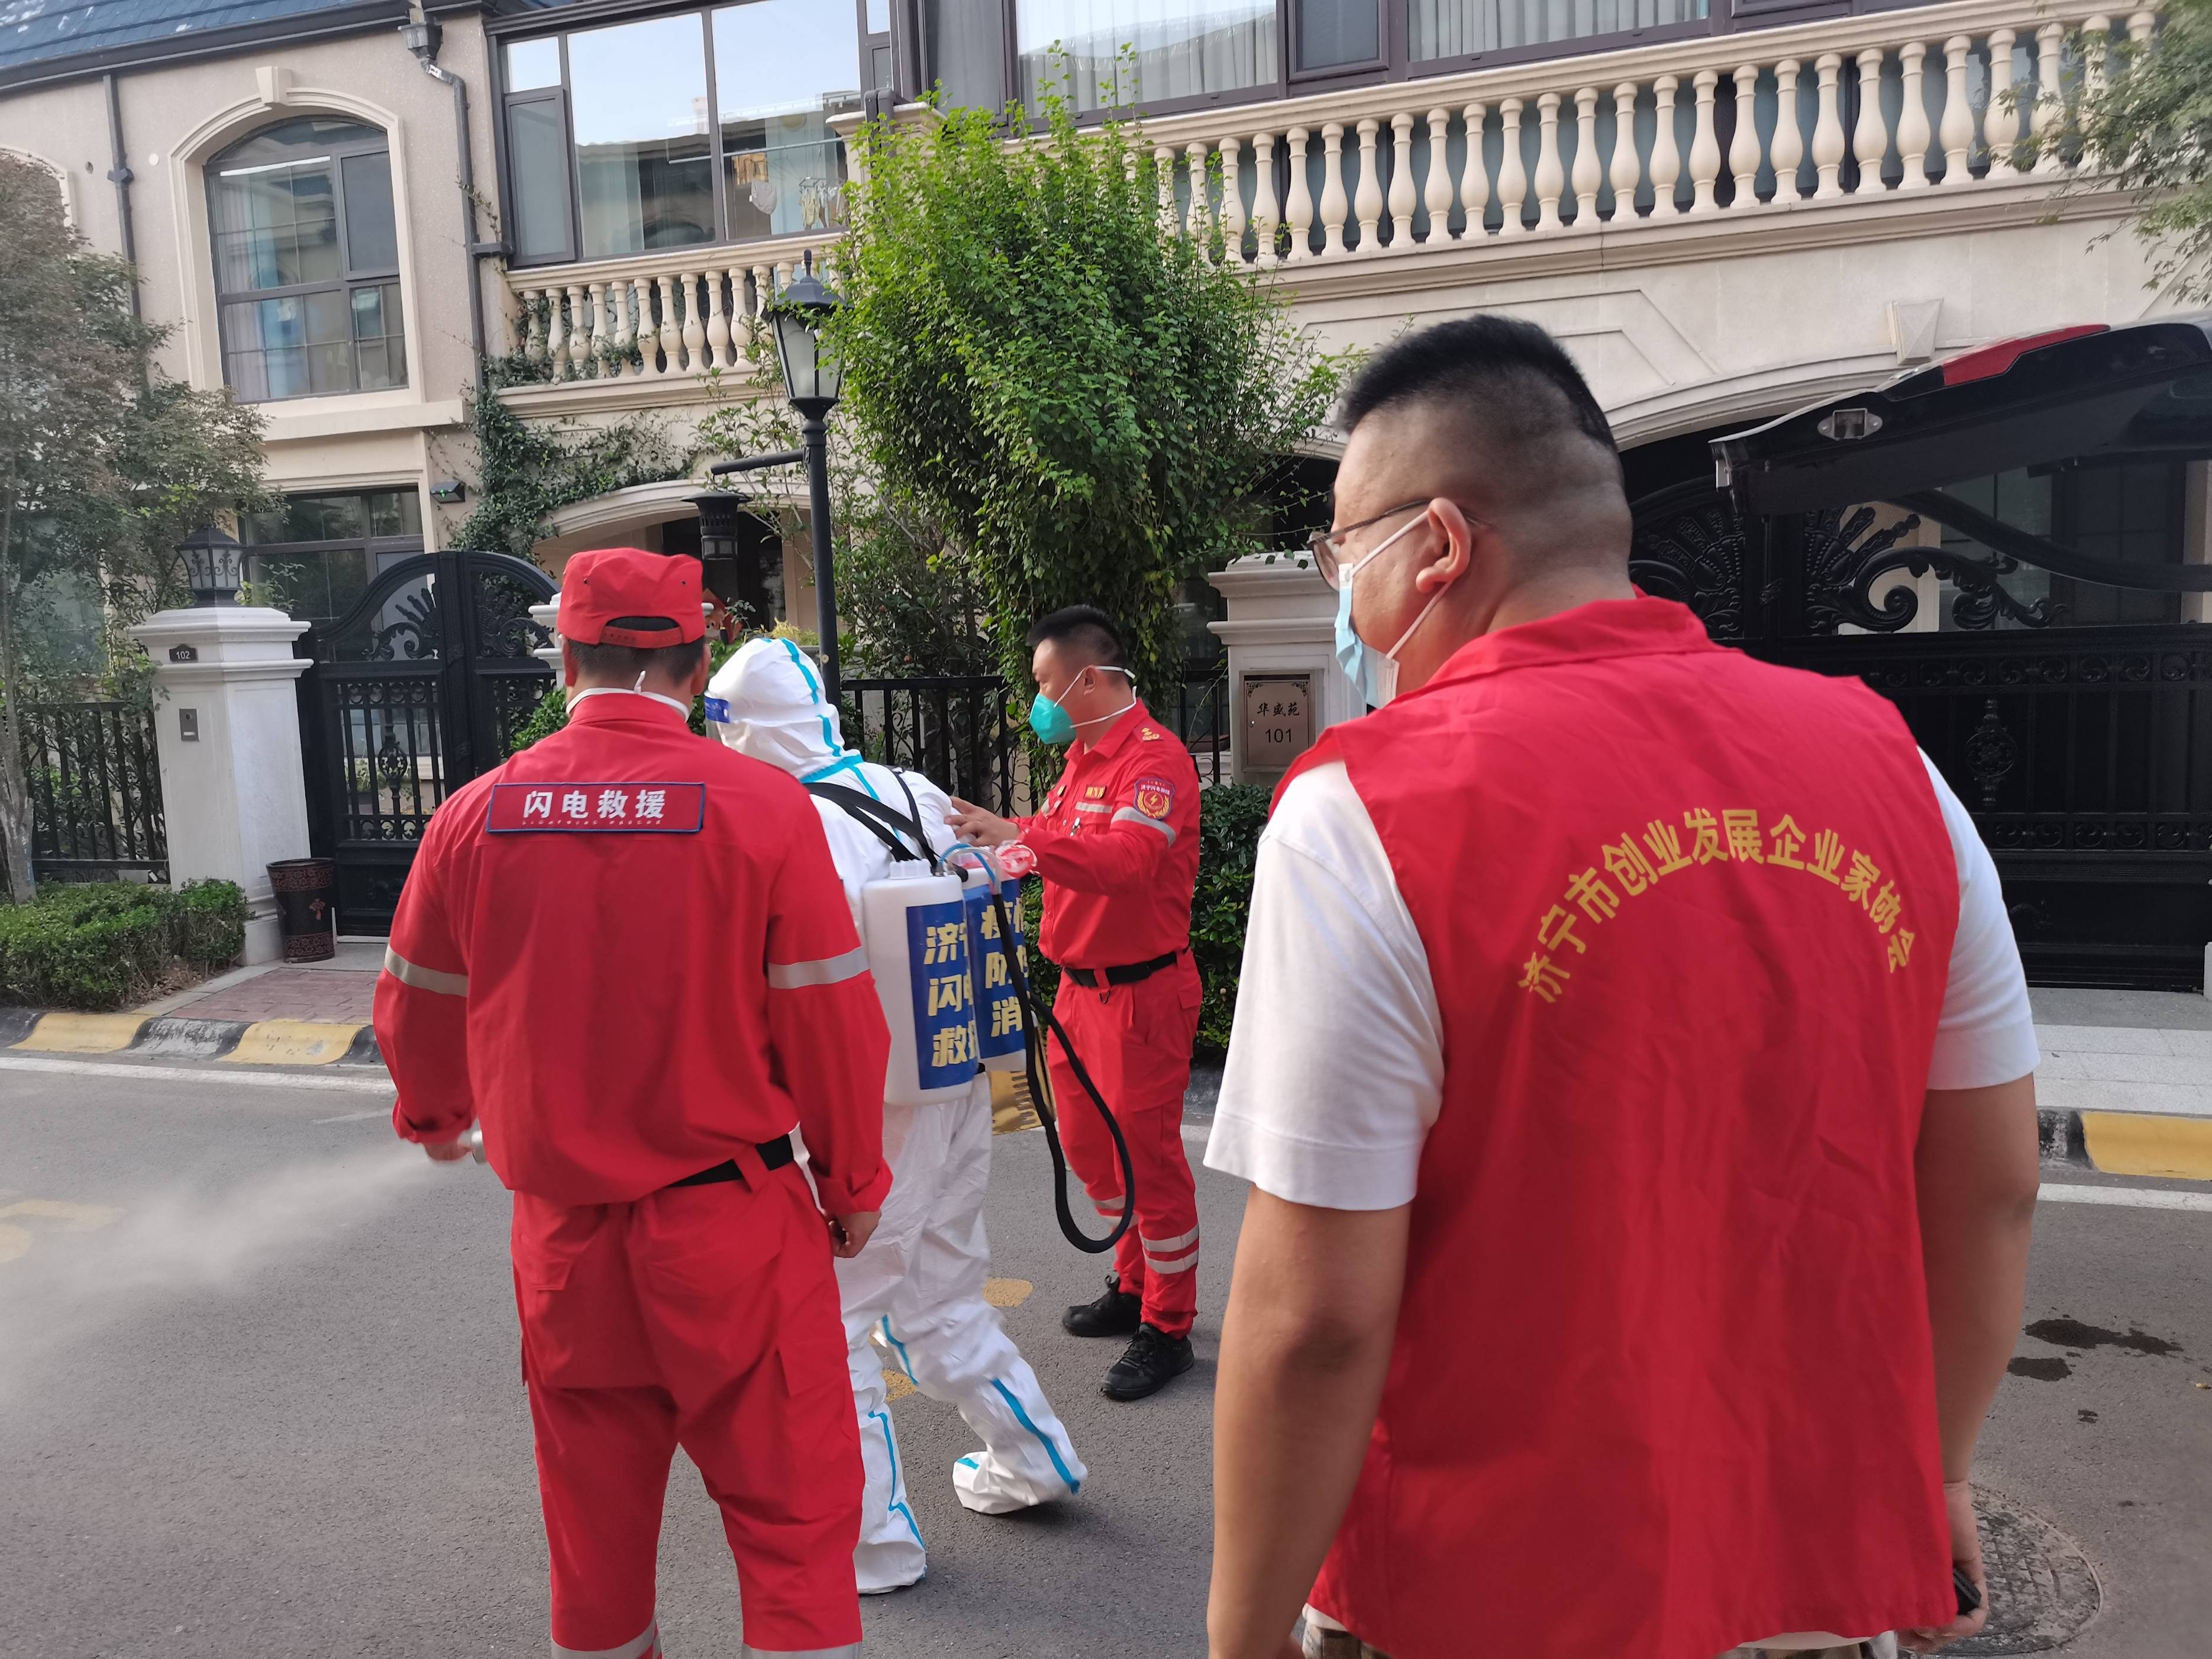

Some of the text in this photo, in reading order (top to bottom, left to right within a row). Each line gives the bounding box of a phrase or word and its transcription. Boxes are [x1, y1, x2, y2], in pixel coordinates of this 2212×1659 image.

[176, 651, 190, 660] 102
[1265, 728, 1291, 743] 101
[522, 789, 666, 818] 闪电救援
[1517, 808, 1915, 1003] 济宁市创业发展企业家协会
